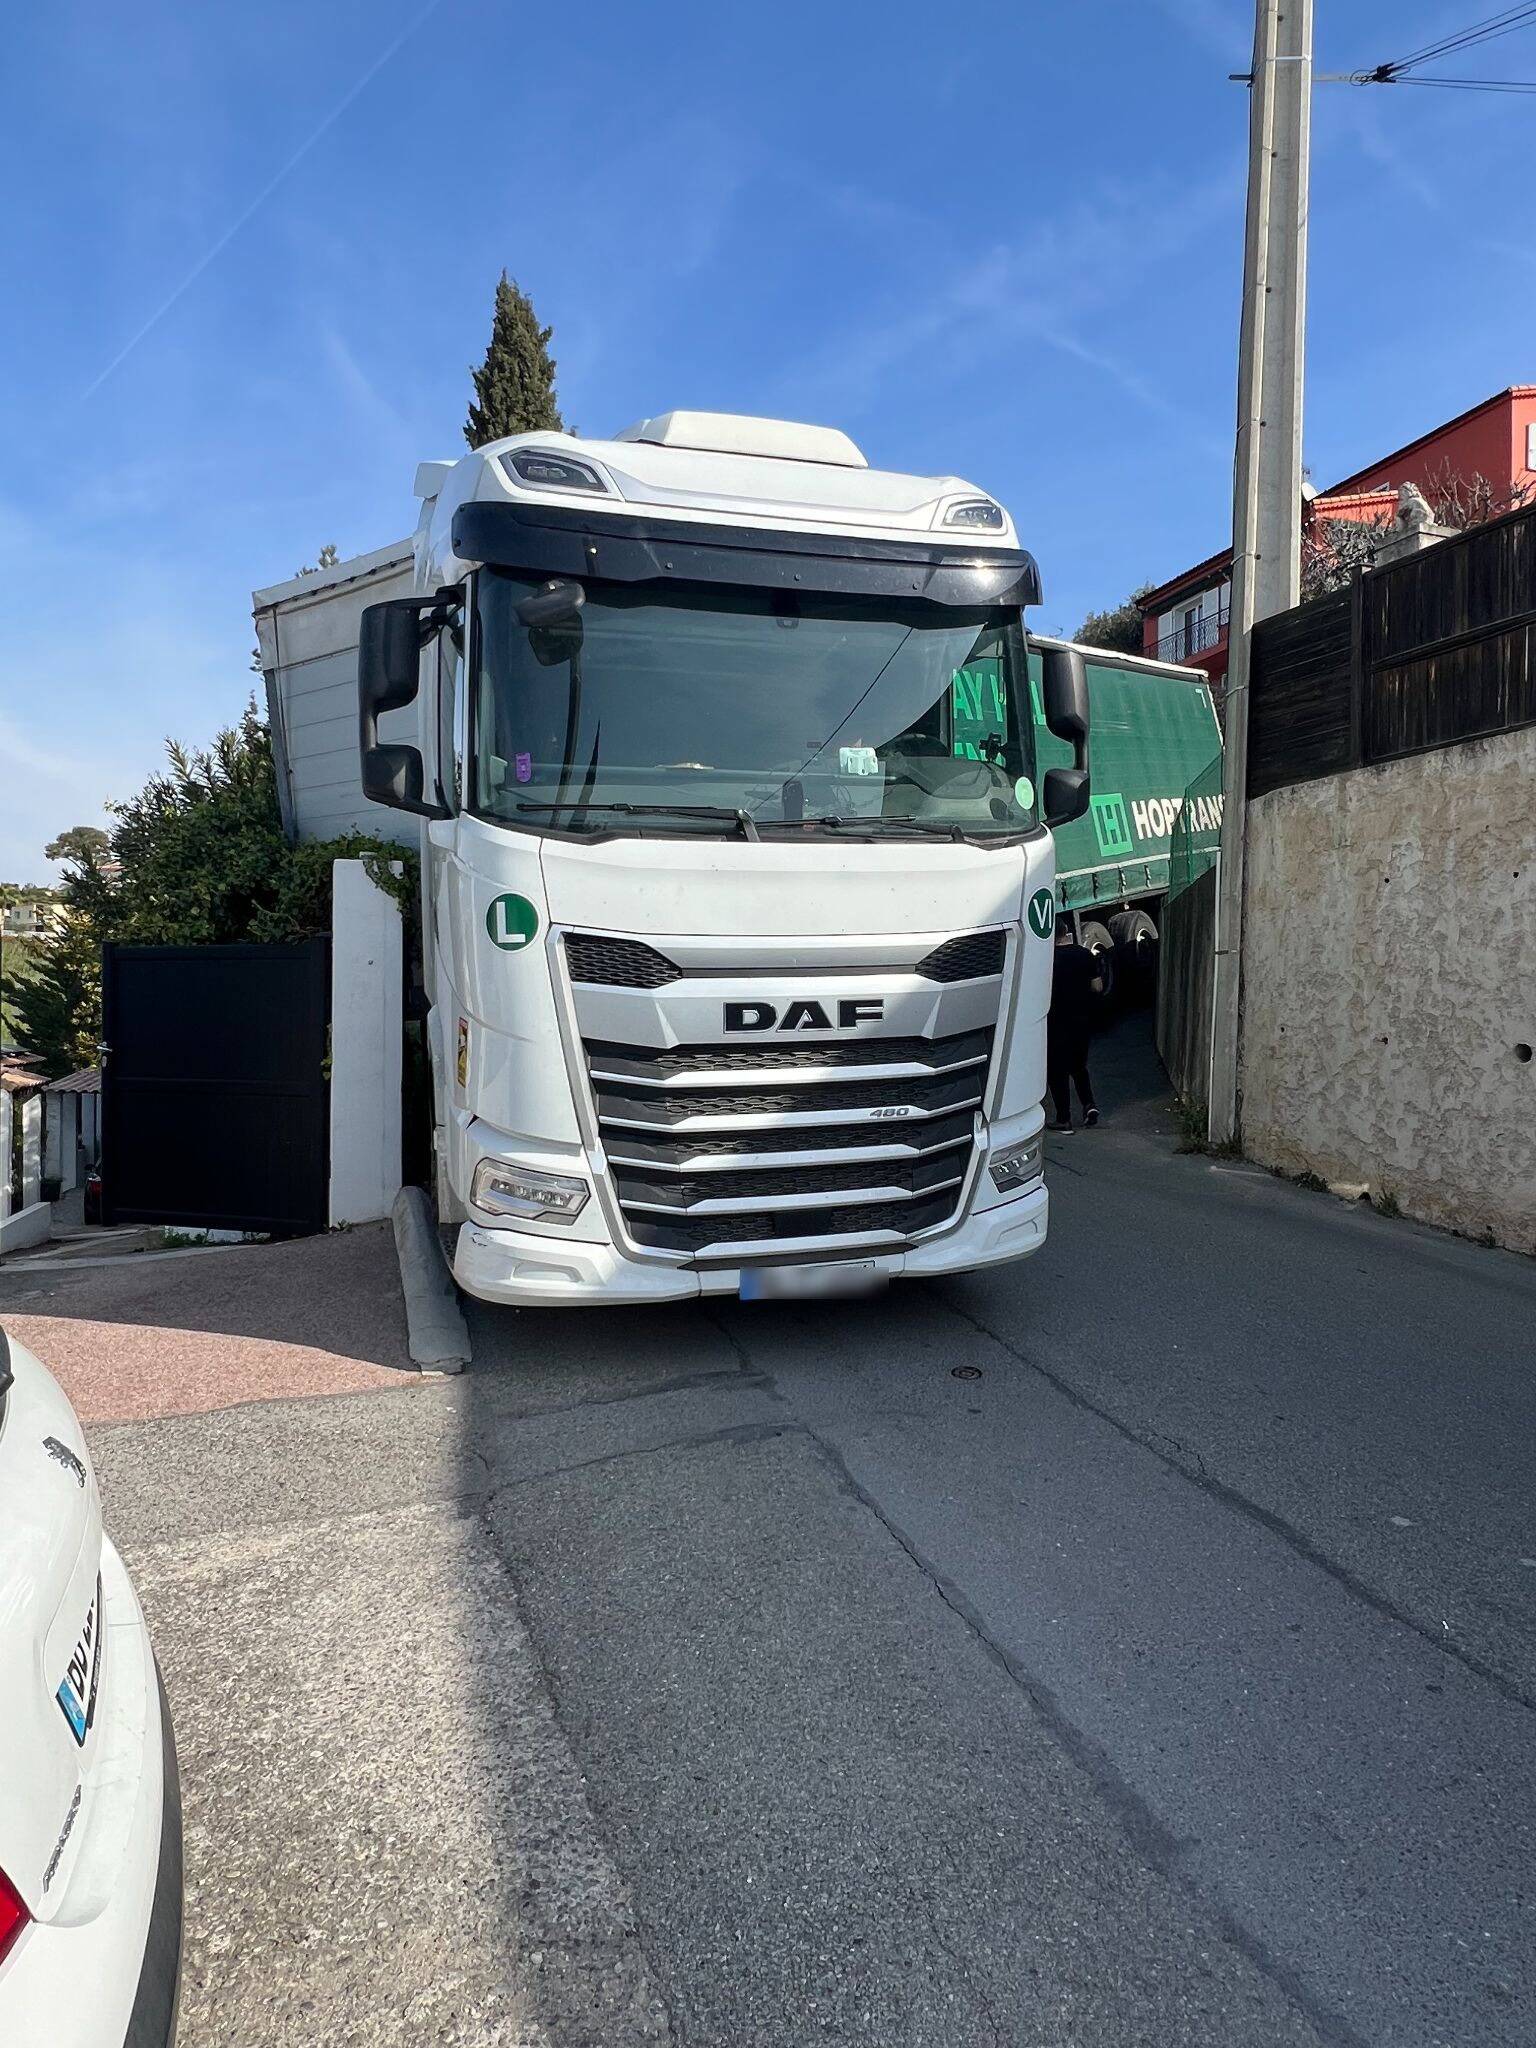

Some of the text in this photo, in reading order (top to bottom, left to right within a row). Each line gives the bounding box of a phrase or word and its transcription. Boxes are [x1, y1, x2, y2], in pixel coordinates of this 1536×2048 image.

[496, 901, 526, 944] L
[1033, 898, 1052, 929] VI
[722, 998, 885, 1034] DAF
[869, 1107, 910, 1118] 480
